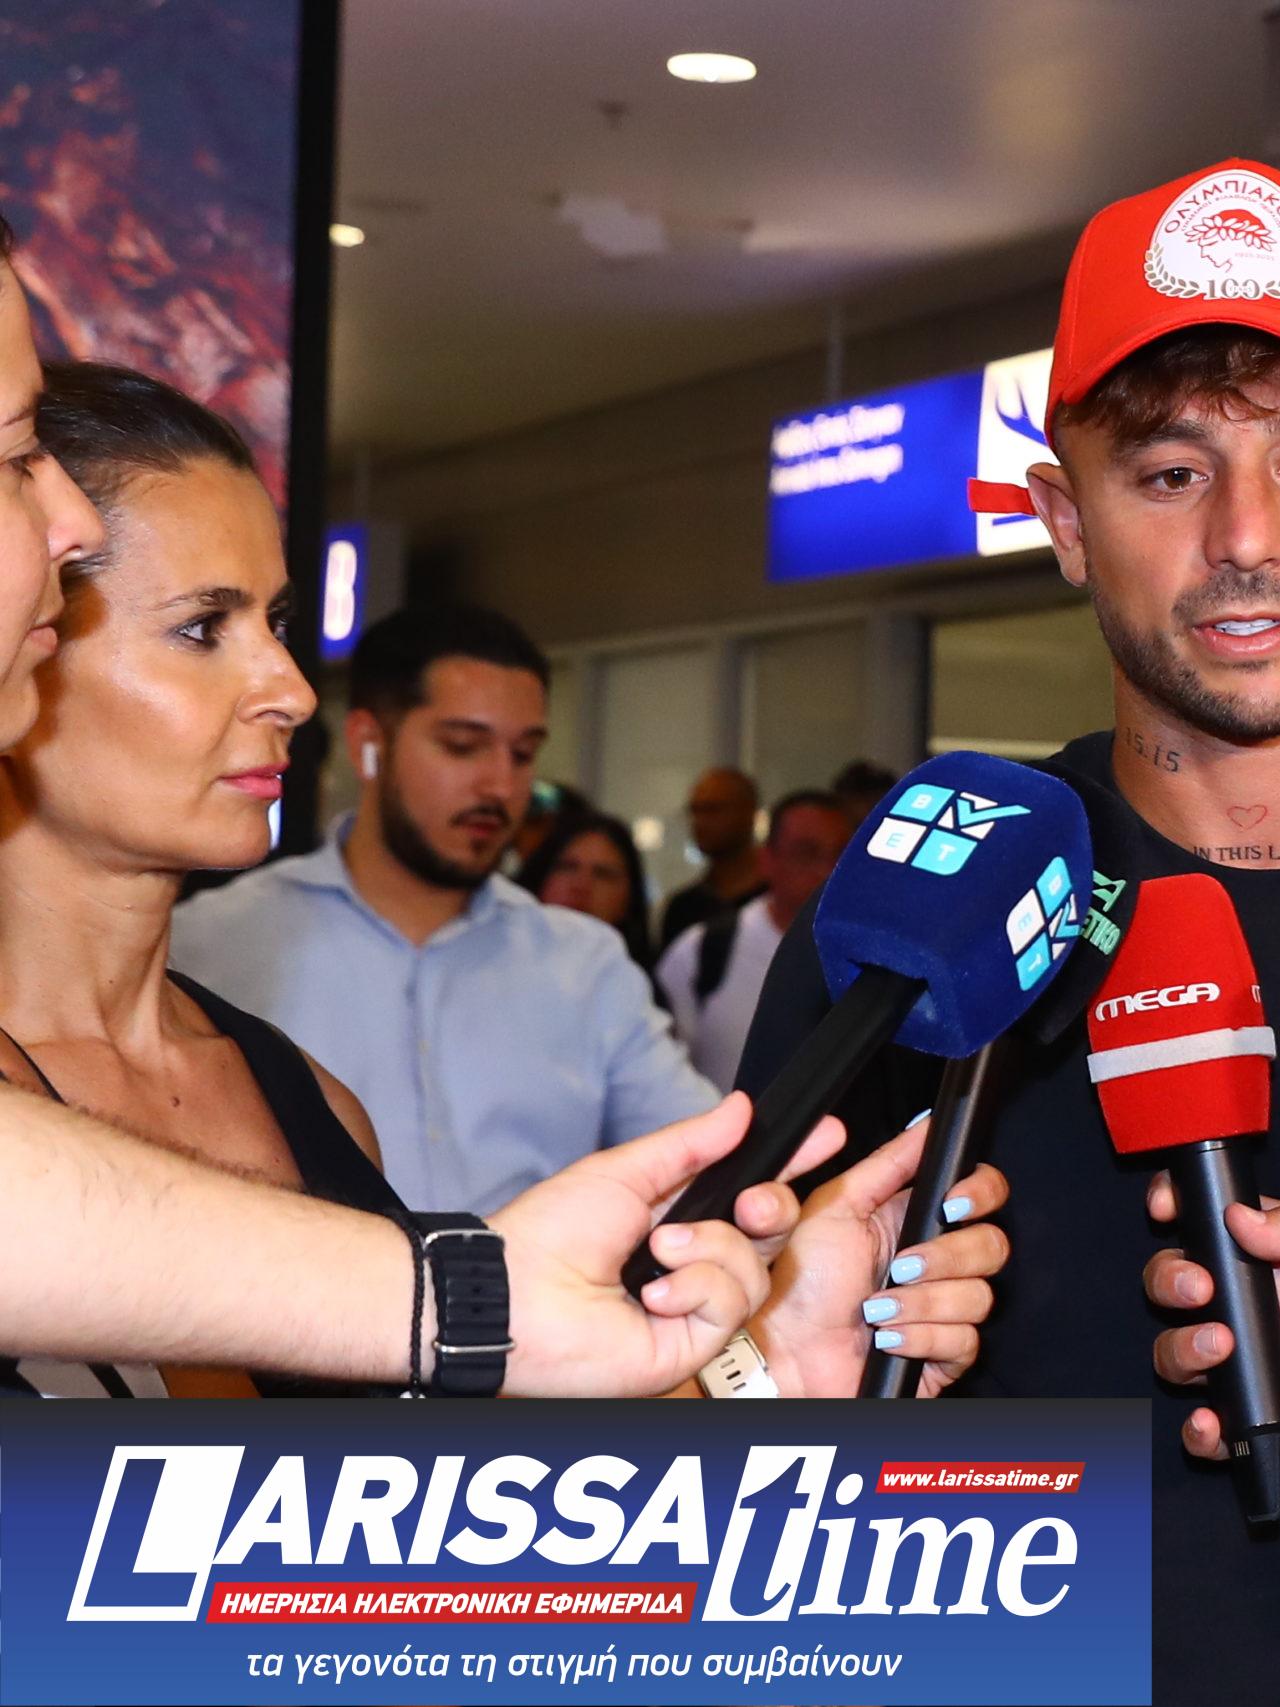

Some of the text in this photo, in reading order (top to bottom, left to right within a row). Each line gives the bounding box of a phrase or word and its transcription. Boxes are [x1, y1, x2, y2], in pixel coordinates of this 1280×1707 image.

[1207, 278, 1261, 299] 100
[1215, 846, 1262, 861] THIS
[1095, 982, 1221, 1022] MEGA
